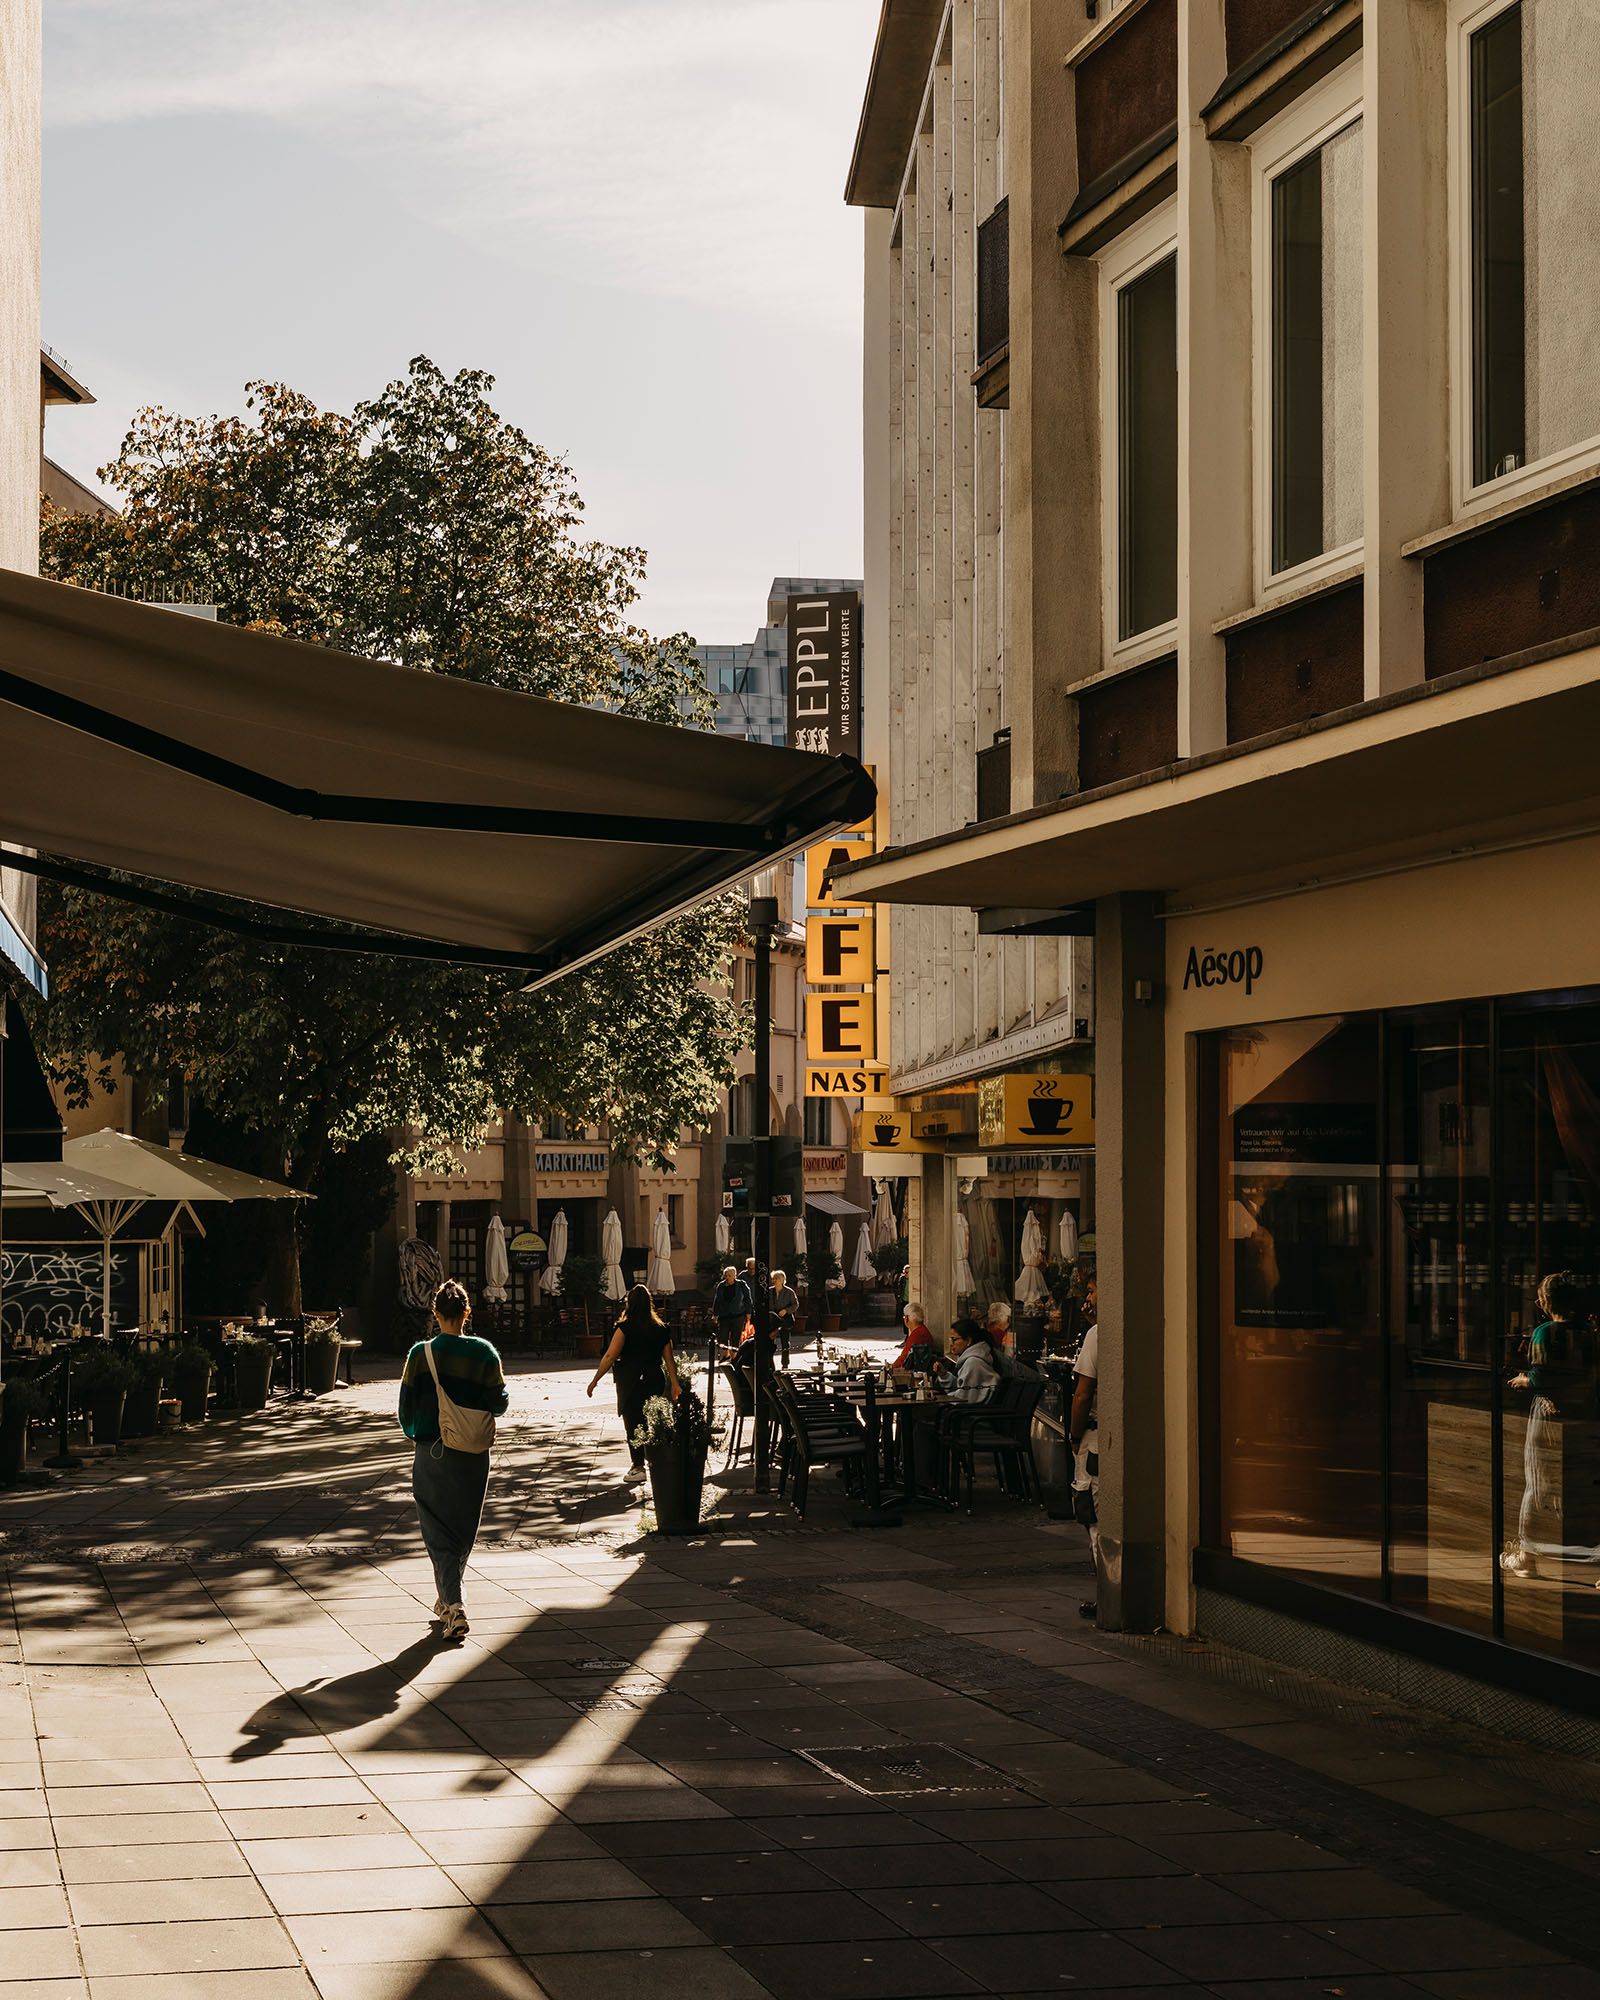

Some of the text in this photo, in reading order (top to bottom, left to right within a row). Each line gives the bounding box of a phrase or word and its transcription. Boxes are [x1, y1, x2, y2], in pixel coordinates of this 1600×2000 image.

[796, 601, 830, 718] EPPLI
[839, 608, 850, 736] WIR SCHÄTZEN WERTE
[811, 1072, 887, 1094] NAST
[1239, 1128, 1270, 1137] Vertrauen
[1272, 1128, 1285, 1137] wir
